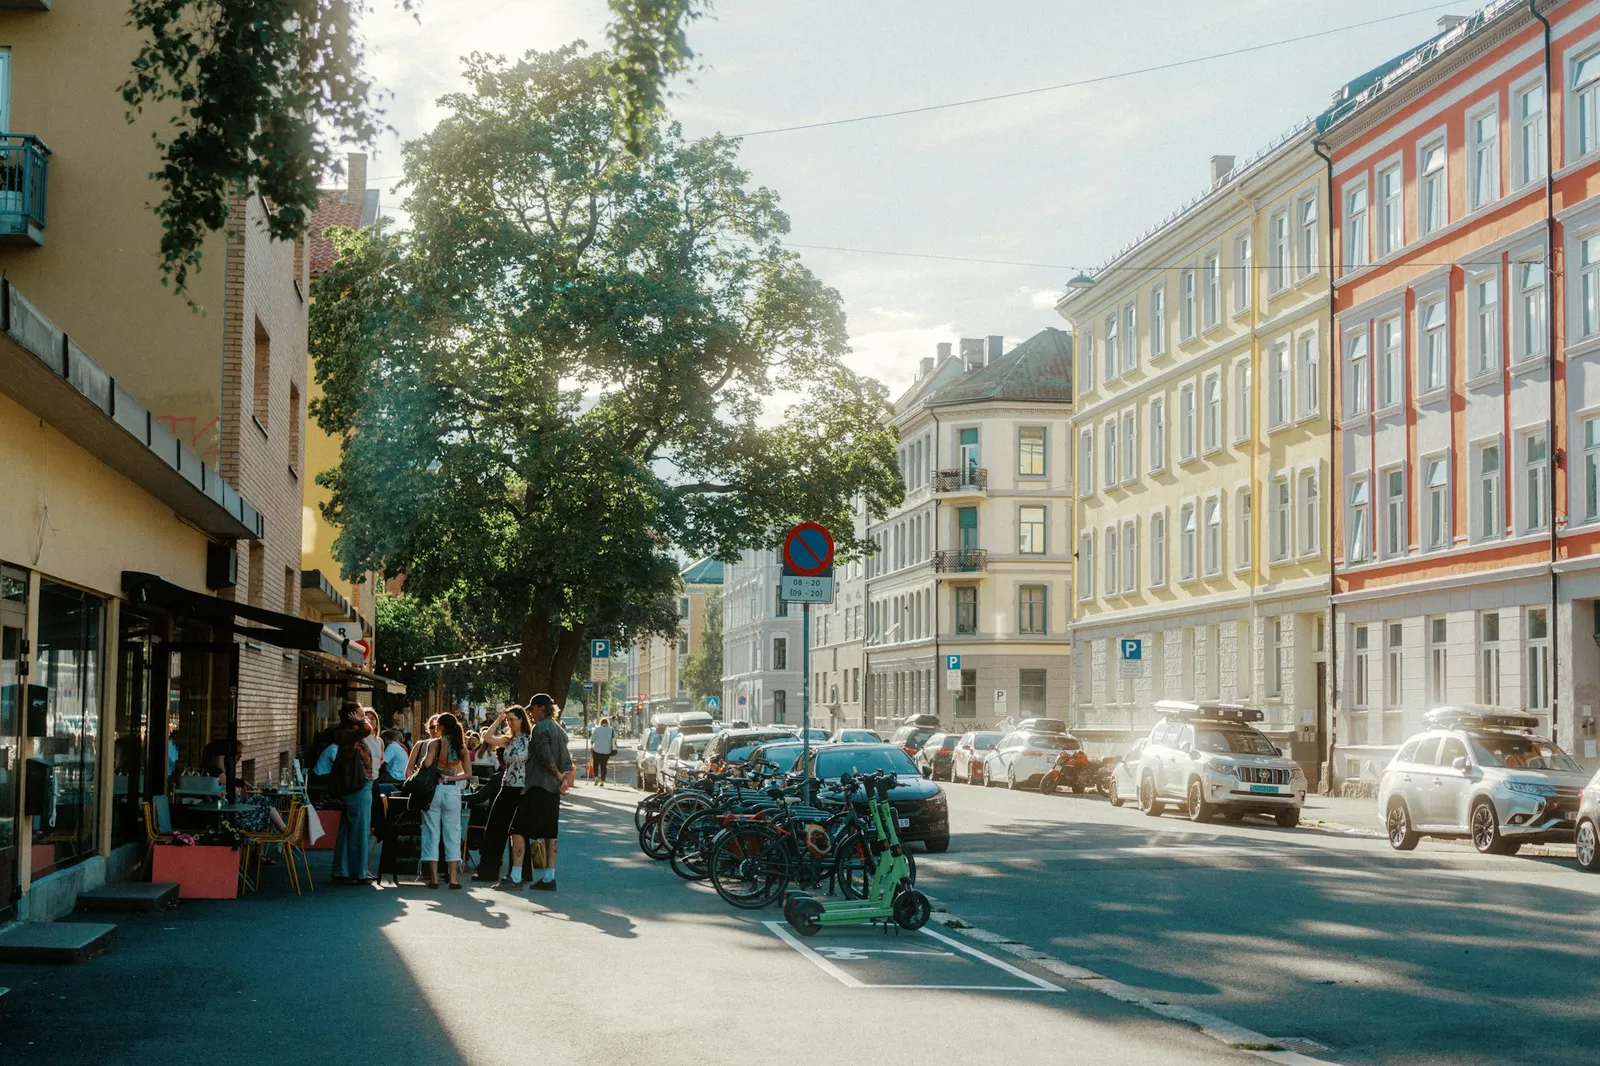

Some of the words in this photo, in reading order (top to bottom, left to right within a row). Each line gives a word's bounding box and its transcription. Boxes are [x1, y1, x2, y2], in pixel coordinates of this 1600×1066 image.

[790, 588, 802, 597] (09
[810, 590, 822, 598] 20)
[596, 642, 606, 656] P
[1126, 642, 1137, 658] P
[950, 656, 958, 668] P
[997, 691, 1004, 700] P
